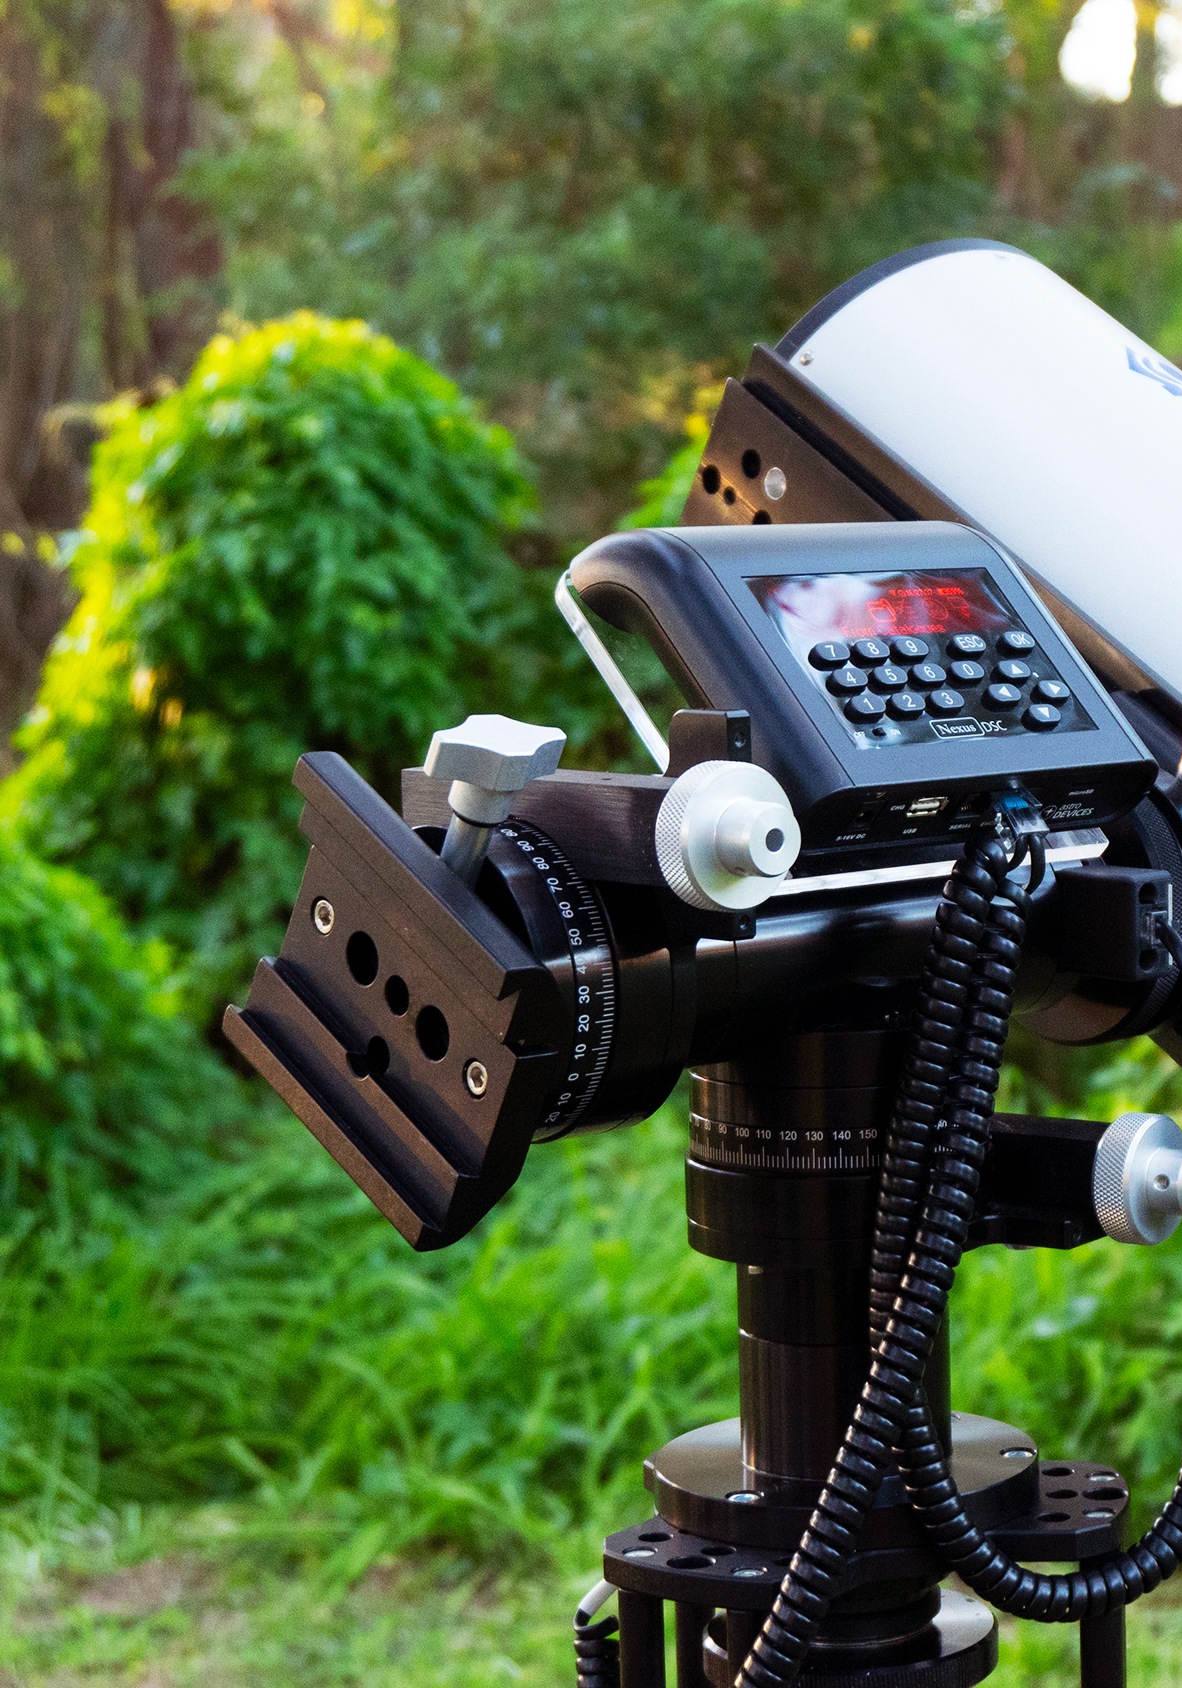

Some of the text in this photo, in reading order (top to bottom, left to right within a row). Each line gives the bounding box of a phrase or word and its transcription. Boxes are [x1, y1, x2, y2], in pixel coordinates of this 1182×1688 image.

[840, 626, 877, 638] From
[825, 633, 1031, 657] 7 8 9 ESC OK
[846, 663, 975, 684] 4 5 6 0
[863, 692, 954, 710] 1 2 3
[853, 728, 901, 739] OFF ON
[935, 720, 1008, 735] Nexus DSC
[1053, 807, 1095, 819] DEVICES
[1059, 802, 1082, 811] astro
[903, 827, 918, 835] USB
[517, 841, 534, 851] 90
[533, 857, 550, 870] 80
[546, 877, 563, 893] 70
[559, 901, 574, 918] 60
[568, 928, 583, 946] 50
[576, 954, 587, 975] 40
[578, 985, 590, 1004] 30
[577, 1014, 590, 1032] 20
[574, 1043, 587, 1060] 10
[567, 1073, 580, 1081] 0
[557, 1092, 571, 1105] 10
[718, 1123, 727, 1135] 90
[735, 1127, 750, 1137] 100
[756, 1129, 772, 1139] 110
[780, 1130, 798, 1140] 120
[805, 1131, 824, 1141] 130
[832, 1130, 851, 1140] 140
[860, 1128, 878, 1139] 150
